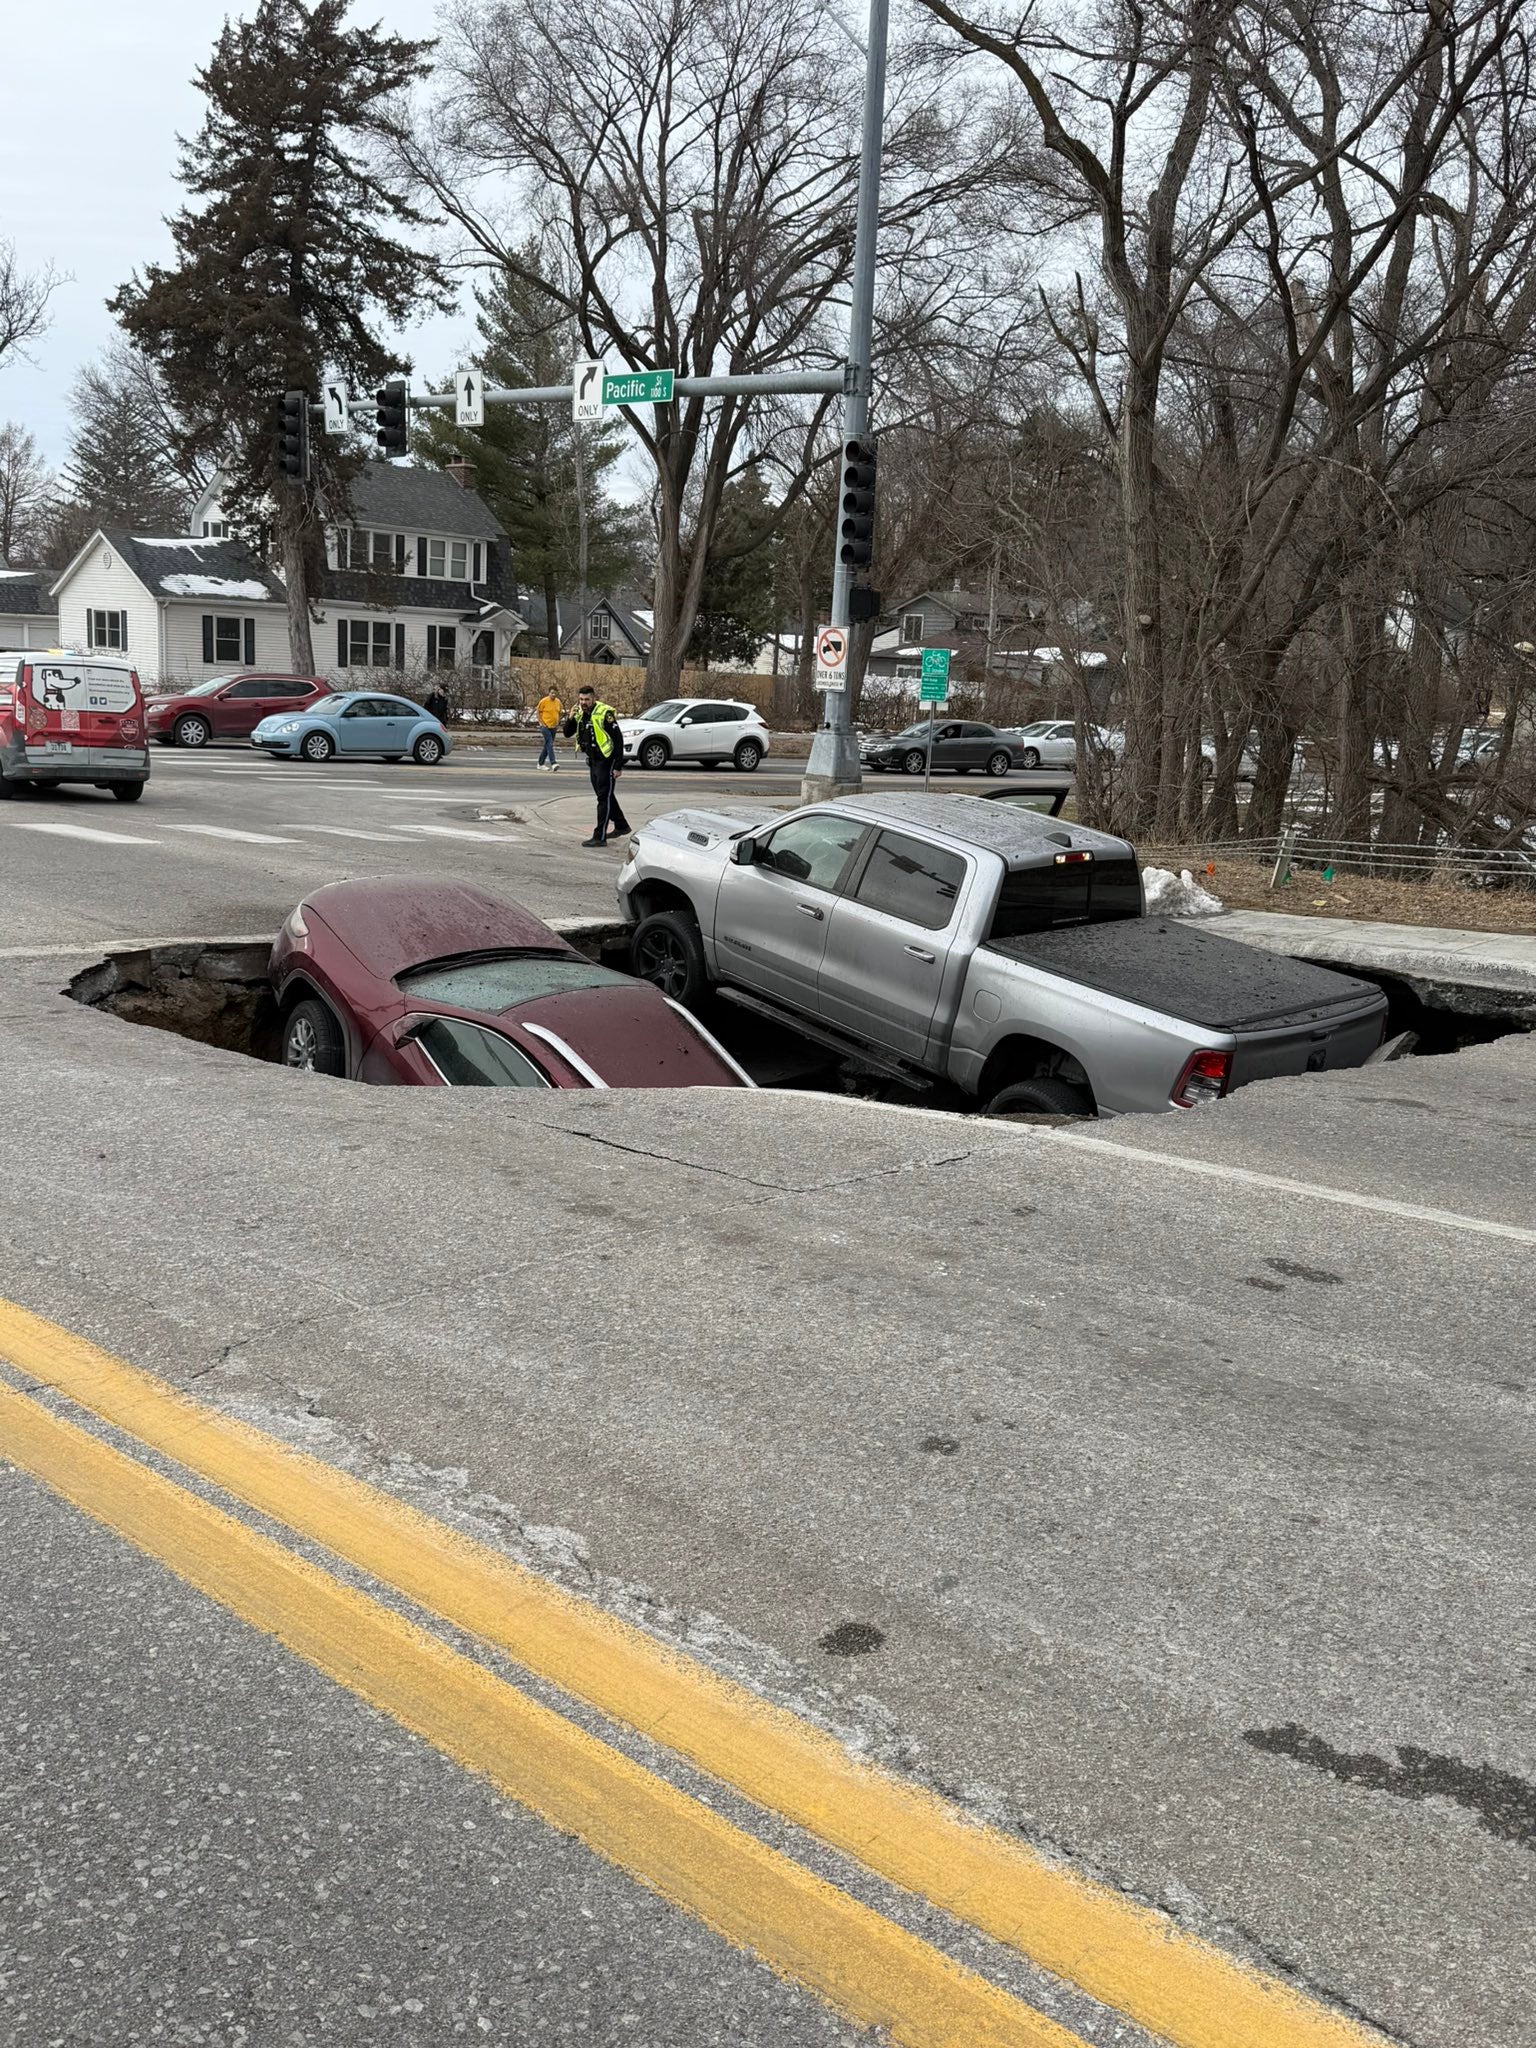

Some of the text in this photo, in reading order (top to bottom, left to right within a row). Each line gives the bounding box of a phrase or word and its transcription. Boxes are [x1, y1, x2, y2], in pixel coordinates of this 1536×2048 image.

[606, 380, 646, 399] Pacific
[662, 386, 667, 398] S
[460, 410, 479, 422] ONLY
[578, 404, 599, 417] ONLY
[328, 419, 344, 430] ONLY
[828, 671, 833, 680] 6
[833, 671, 846, 681] TONS
